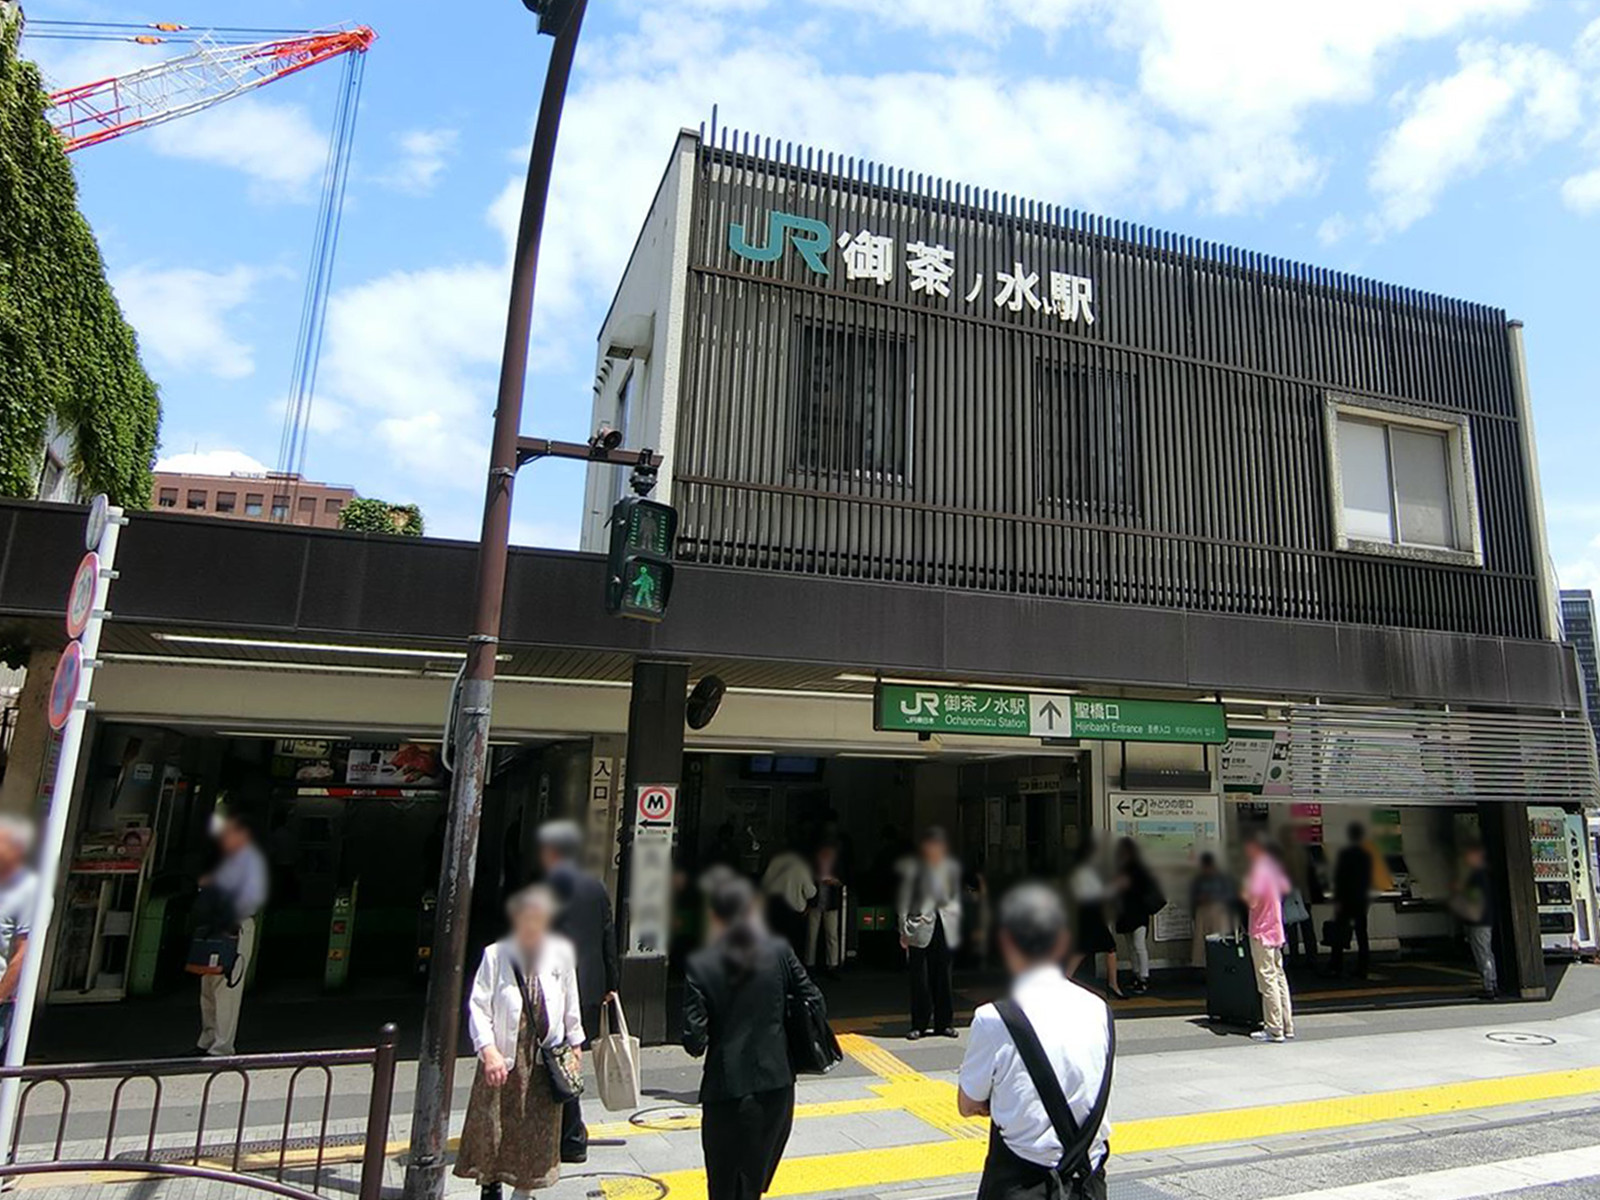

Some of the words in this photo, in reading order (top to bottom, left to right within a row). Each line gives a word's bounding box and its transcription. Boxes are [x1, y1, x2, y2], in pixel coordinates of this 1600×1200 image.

[729, 210, 831, 275] JR
[837, 229, 1095, 326] 御茶ノ水駅
[900, 692, 940, 716] JR
[944, 693, 1027, 716] 御茶ノ水駅
[1074, 702, 1120, 720] 聖橋口
[945, 714, 997, 727] Ochanomizu
[998, 716, 1027, 728] Station
[1112, 723, 1143, 734] Entrance
[593, 760, 611, 800] 入口
[647, 795, 664, 810] M
[1149, 799, 1194, 809] みどりの窓口
[335, 898, 349, 908] IC
